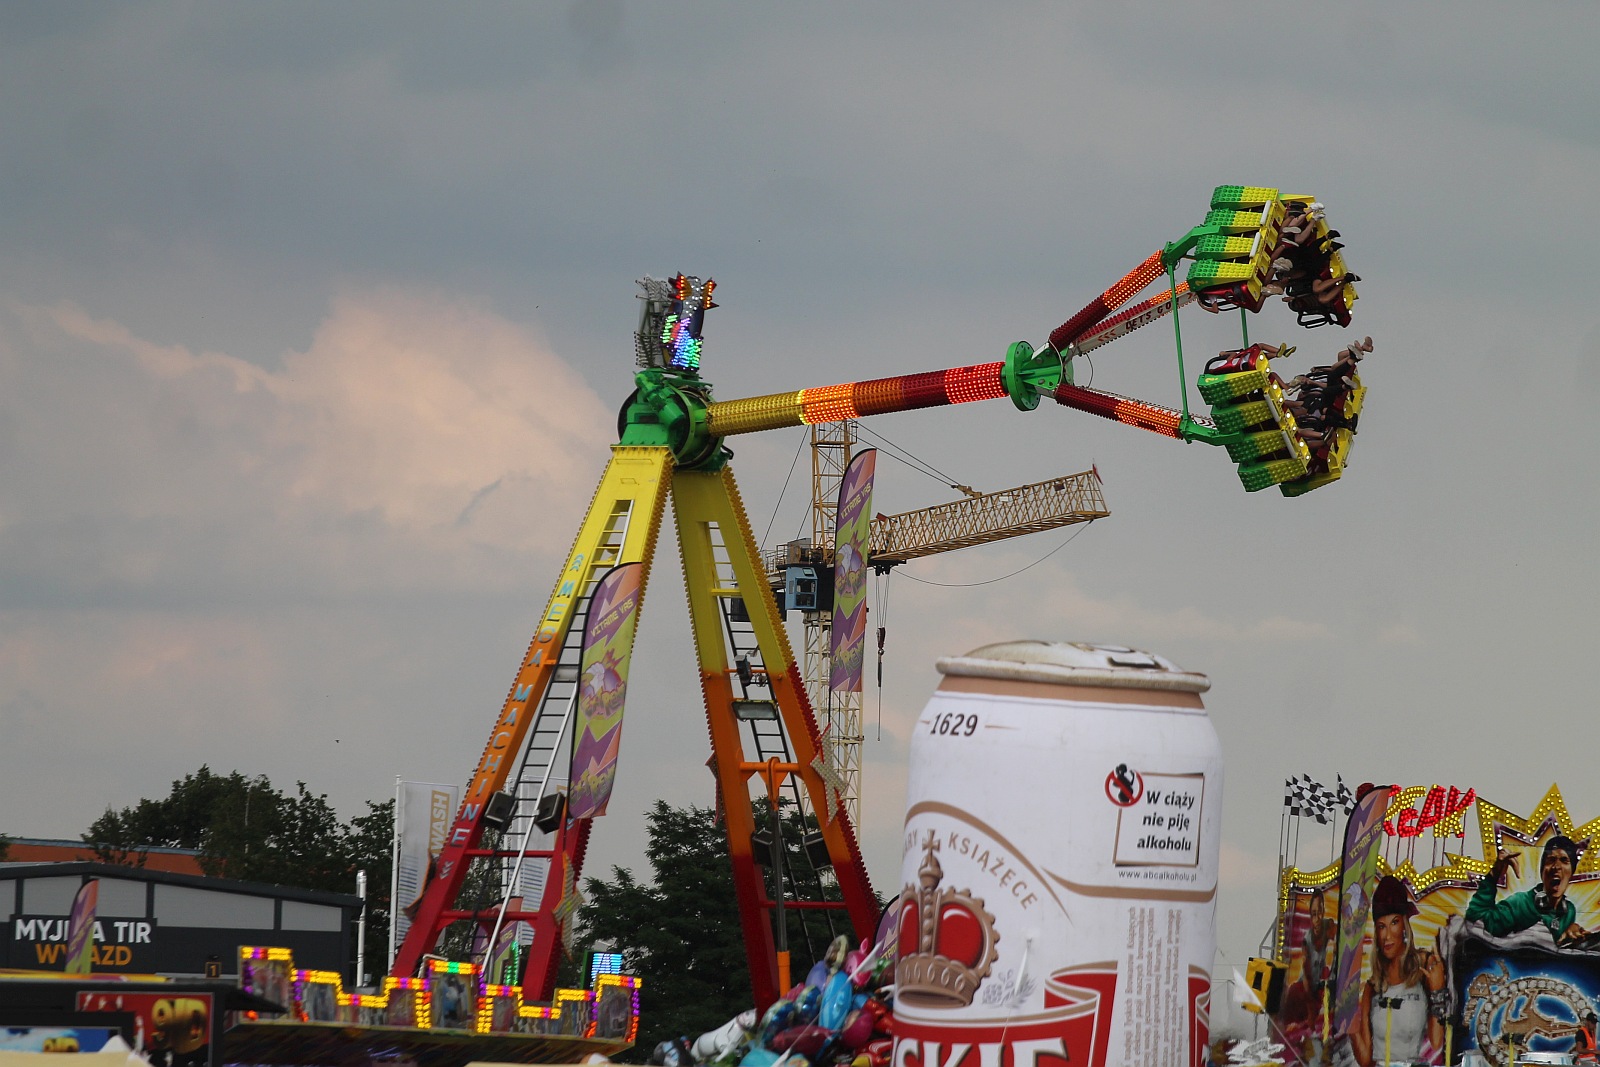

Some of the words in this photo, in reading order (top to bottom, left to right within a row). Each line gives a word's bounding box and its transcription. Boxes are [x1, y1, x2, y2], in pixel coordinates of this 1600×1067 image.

[526, 579, 576, 668] MEGA
[930, 713, 978, 736] 1629
[450, 683, 534, 848] MACHINE
[1147, 791, 1161, 805] W
[1164, 791, 1195, 810] ciąży
[1142, 812, 1164, 826] nie
[1167, 813, 1190, 831] piję
[1137, 835, 1191, 851] alkoholu
[948, 831, 1038, 910] KSIĄŻĘCE
[1119, 871, 1197, 883] www.abcalkoholu.pl
[15, 919, 105, 943] MYJA
[114, 921, 151, 944] TIR
[210, 965, 217, 977] 1
